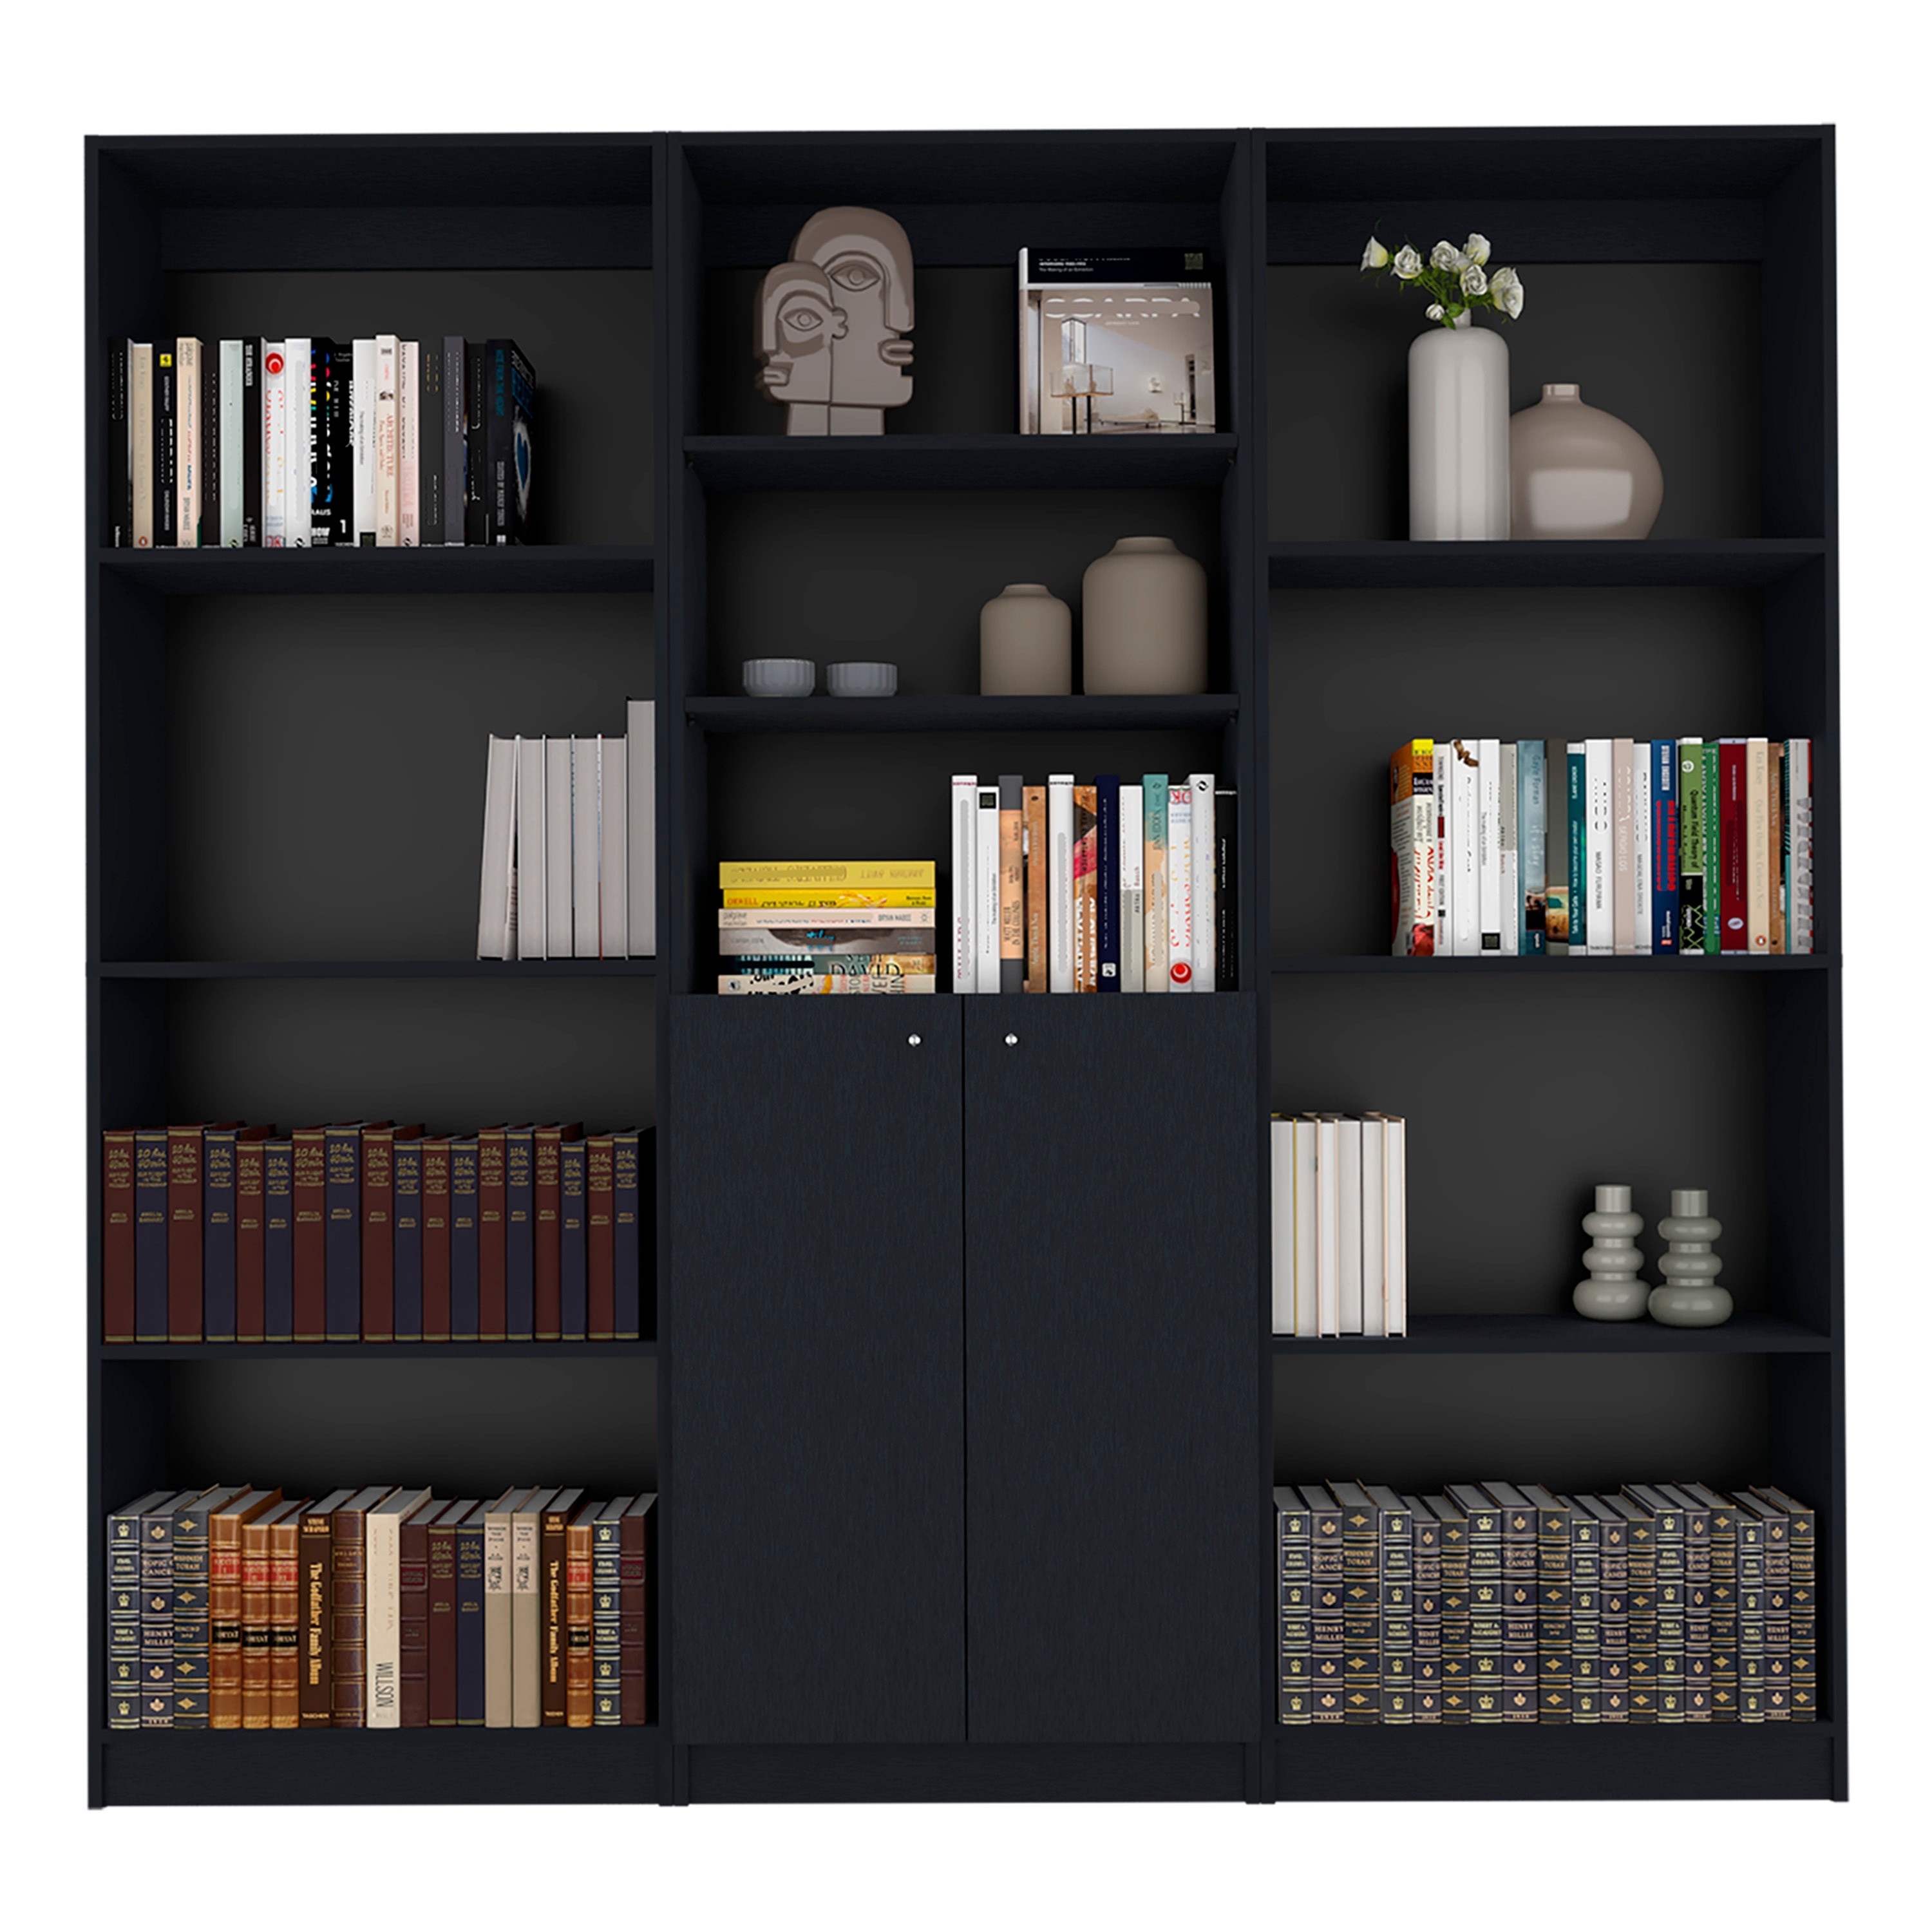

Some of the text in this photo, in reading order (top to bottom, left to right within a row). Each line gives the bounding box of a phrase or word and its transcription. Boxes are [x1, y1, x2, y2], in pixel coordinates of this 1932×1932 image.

[339, 519, 346, 533] 1
[1531, 755, 1540, 804] Gayle Forman
[1690, 790, 1699, 819] Quantum
[1690, 821, 1699, 837] Field
[1619, 826, 1627, 871] SERGIO LOS
[1689, 838, 1699, 859] Theory
[375, 1662, 394, 1708] WILLSON
